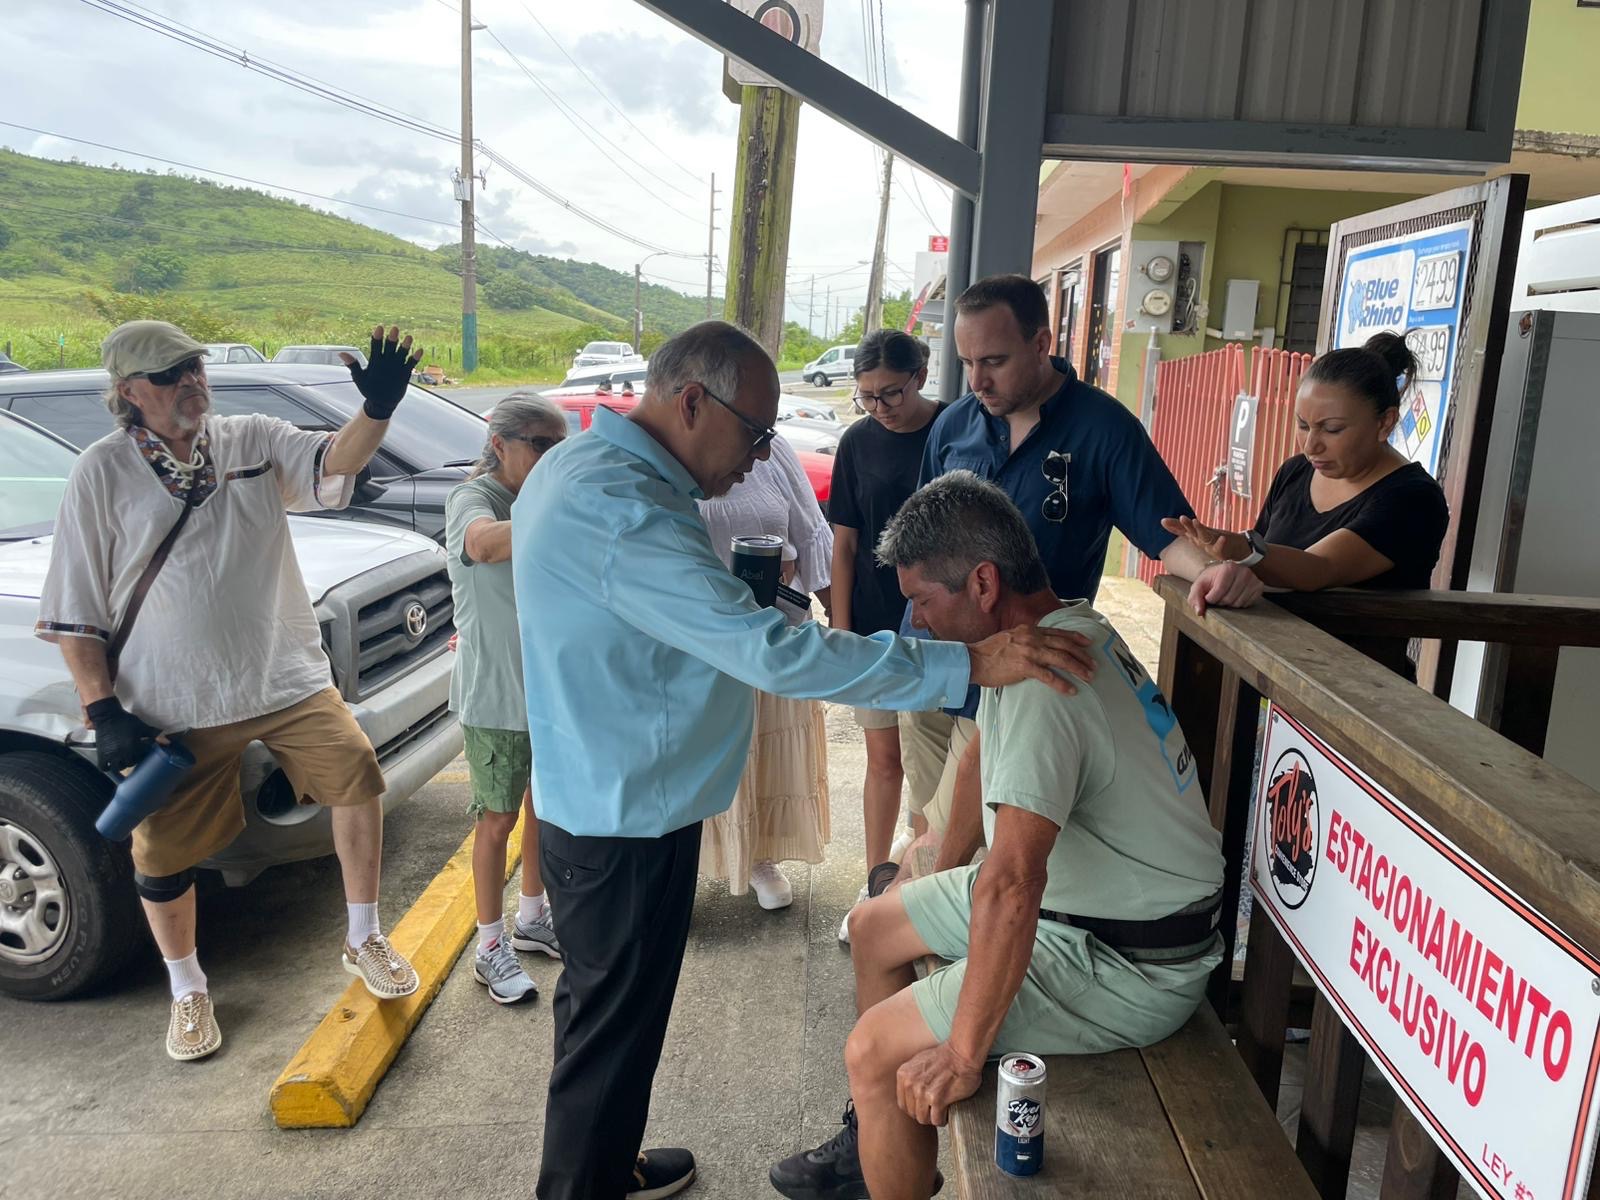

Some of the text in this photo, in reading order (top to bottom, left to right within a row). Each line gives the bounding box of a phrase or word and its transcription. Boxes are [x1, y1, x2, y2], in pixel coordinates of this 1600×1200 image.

[1366, 278, 1400, 301] Blue
[1359, 302, 1403, 327] Rhino
[1413, 398, 1422, 417] 4
[1235, 400, 1250, 442] P
[1420, 416, 1427, 436] 0
[1326, 809, 1572, 1082] ESTACIONAMIENTO
[1350, 916, 1487, 1107] EXCLUSIVO
[1008, 1101, 1040, 1114] Silver
[1014, 1112, 1039, 1127] Key
[1482, 1143, 1513, 1187] LEY
